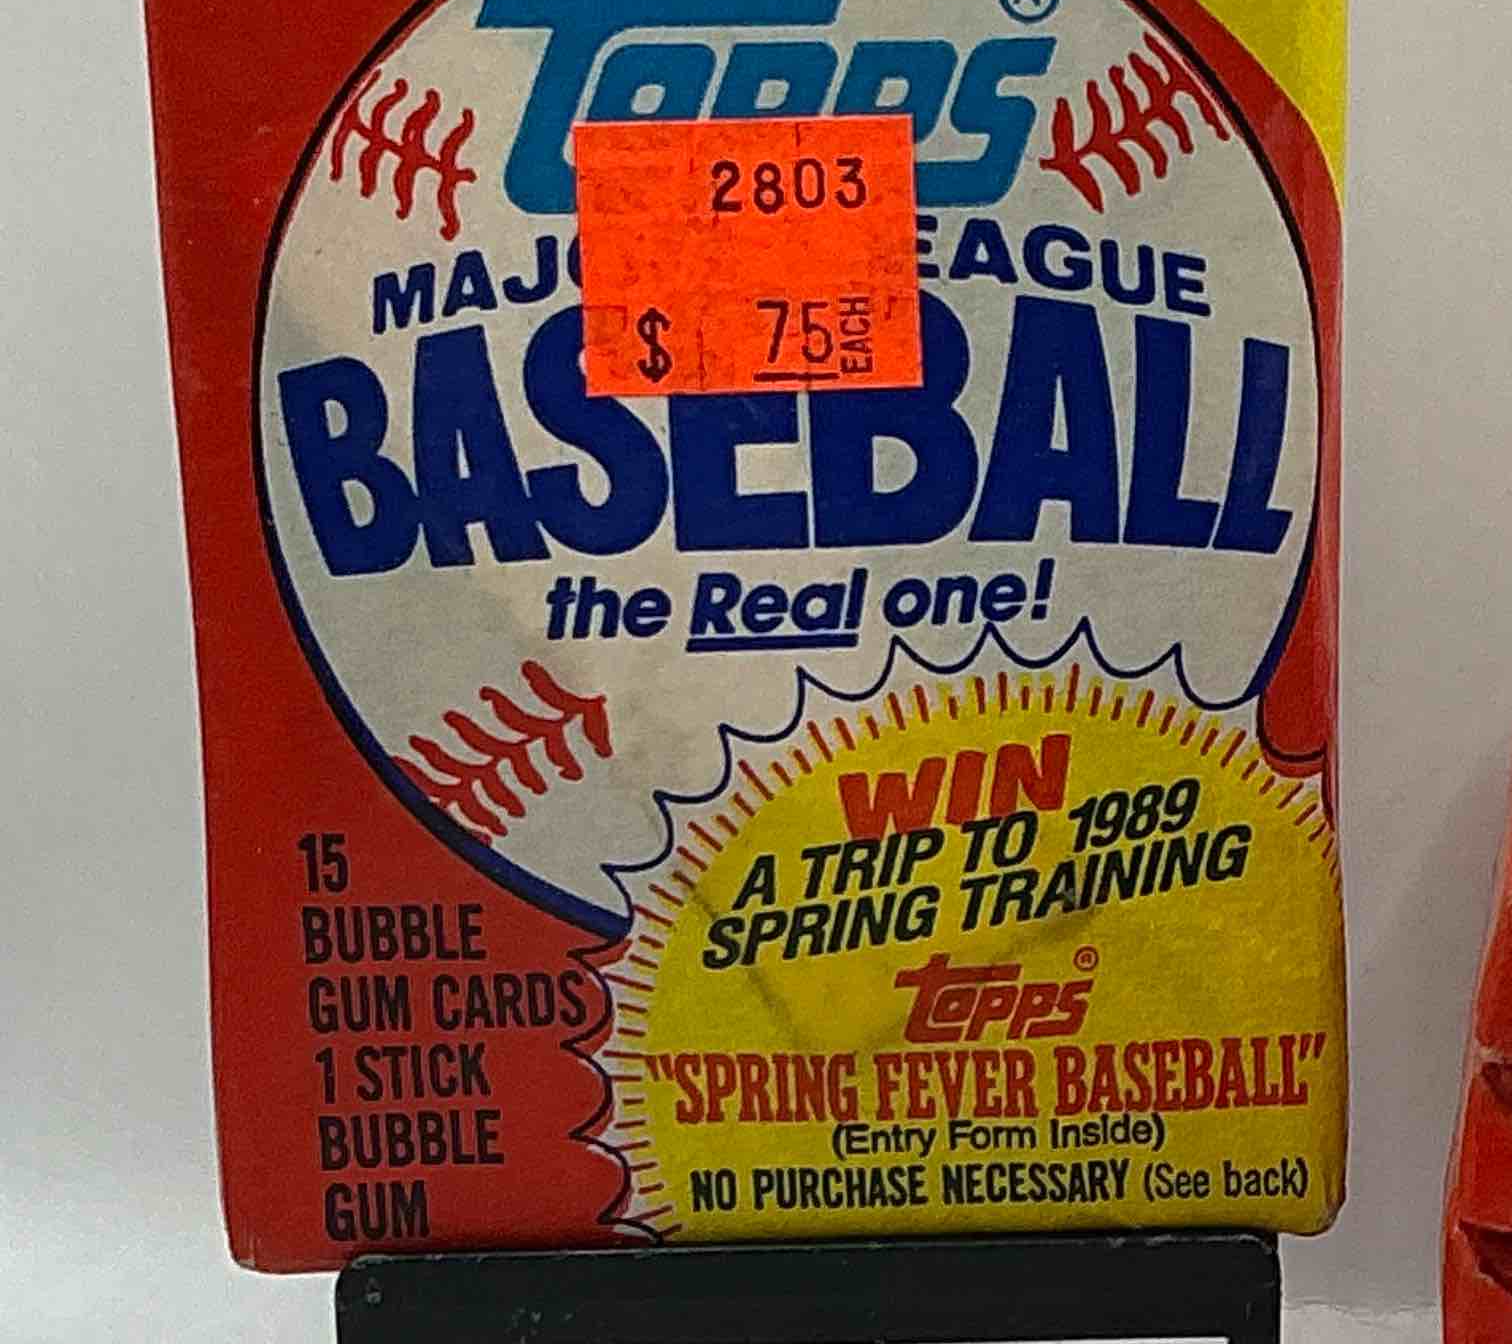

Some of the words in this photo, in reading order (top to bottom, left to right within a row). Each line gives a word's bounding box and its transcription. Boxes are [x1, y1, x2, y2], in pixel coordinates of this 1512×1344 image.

[710, 156, 867, 214] 2803
[372, 236, 583, 336] MAJ
[916, 217, 1213, 318] EAGUE
[637, 306, 673, 383] $
[755, 298, 834, 364] 75
[839, 295, 874, 375] EACH
[278, 294, 1293, 577] BASEBALL
[546, 574, 672, 643] the
[688, 569, 868, 639] Real
[881, 557, 1056, 628] one!
[837, 733, 1072, 842] WIN
[297, 832, 349, 894] 15
[731, 854, 778, 913] A
[799, 827, 945, 900] TRIP
[961, 811, 1038, 873] TO
[1067, 777, 1202, 855] 1989
[701, 884, 942, 971] SPRING
[959, 823, 1253, 932] TRAINING
[301, 903, 488, 965] BUBBLE
[308, 975, 413, 1034] GUM
[432, 970, 588, 1031] CARDS
[315, 1047, 337, 1105] 1
[355, 1041, 492, 1102] STICK
[873, 1047, 1039, 1123] FEVER
[318, 1109, 506, 1171] BUBBLE
[830, 1123, 937, 1161] (Entry
[948, 1119, 1036, 1152] Form
[1049, 1111, 1167, 1150] Inside)
[324, 1179, 431, 1241] GUM
[690, 1168, 738, 1212] NO
[751, 1164, 927, 1210] PURCHASE
[941, 1158, 1129, 1206] NECESSARY
[1143, 1161, 1211, 1202] (See
[1223, 1156, 1310, 1199] back)
